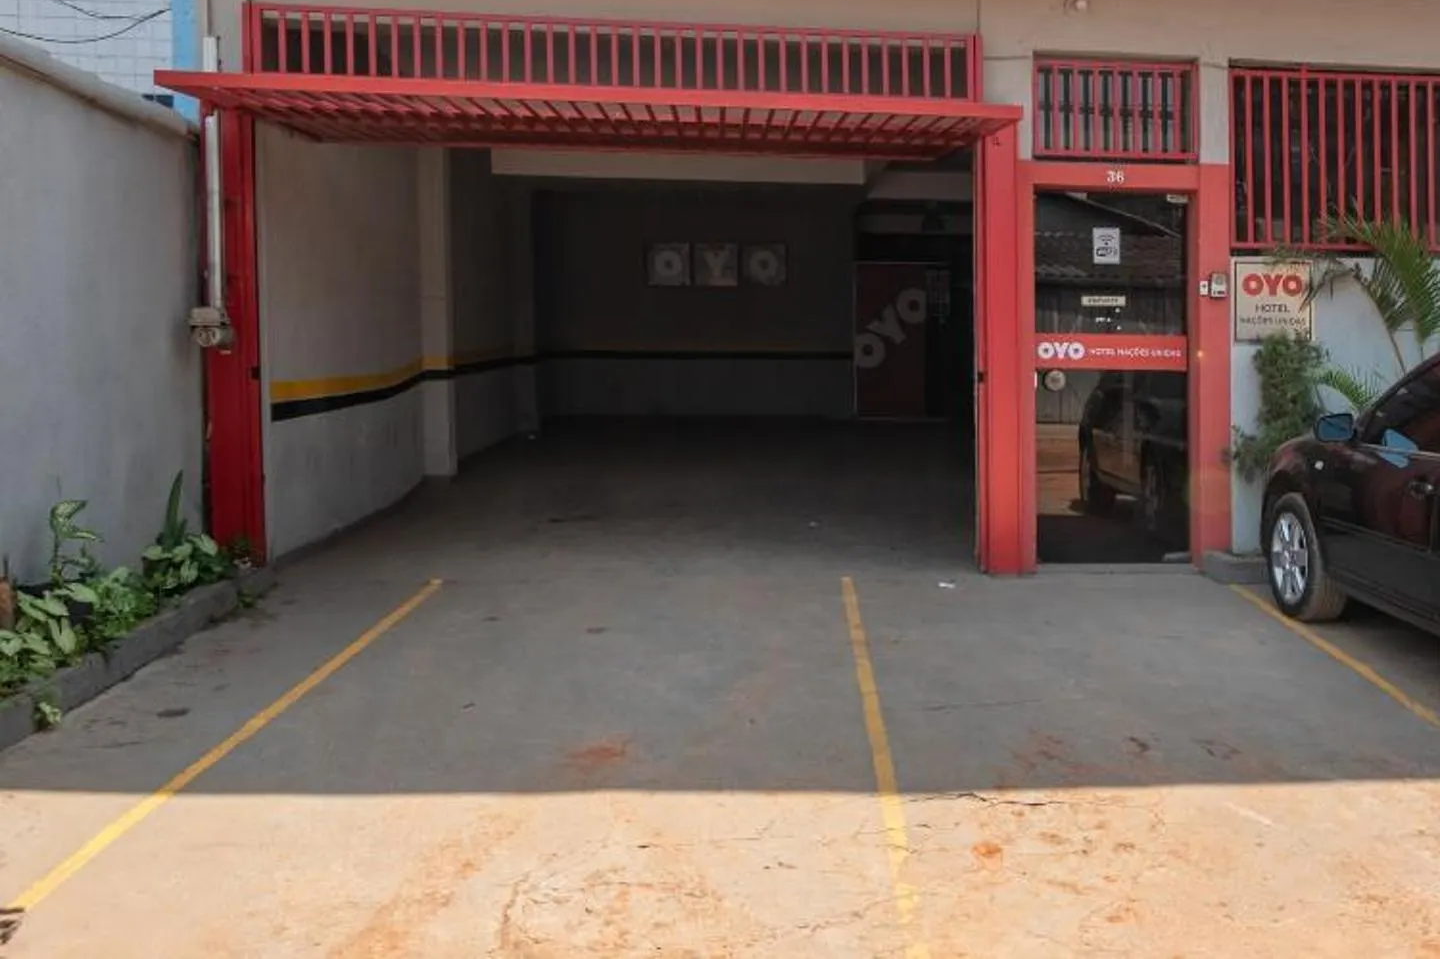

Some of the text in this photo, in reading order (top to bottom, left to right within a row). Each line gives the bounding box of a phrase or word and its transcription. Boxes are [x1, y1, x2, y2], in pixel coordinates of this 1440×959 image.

[1106, 170, 1125, 183] 36
[1242, 273, 1304, 297] OYO
[1254, 303, 1290, 313] HOTEL
[1037, 341, 1085, 360] OYO
